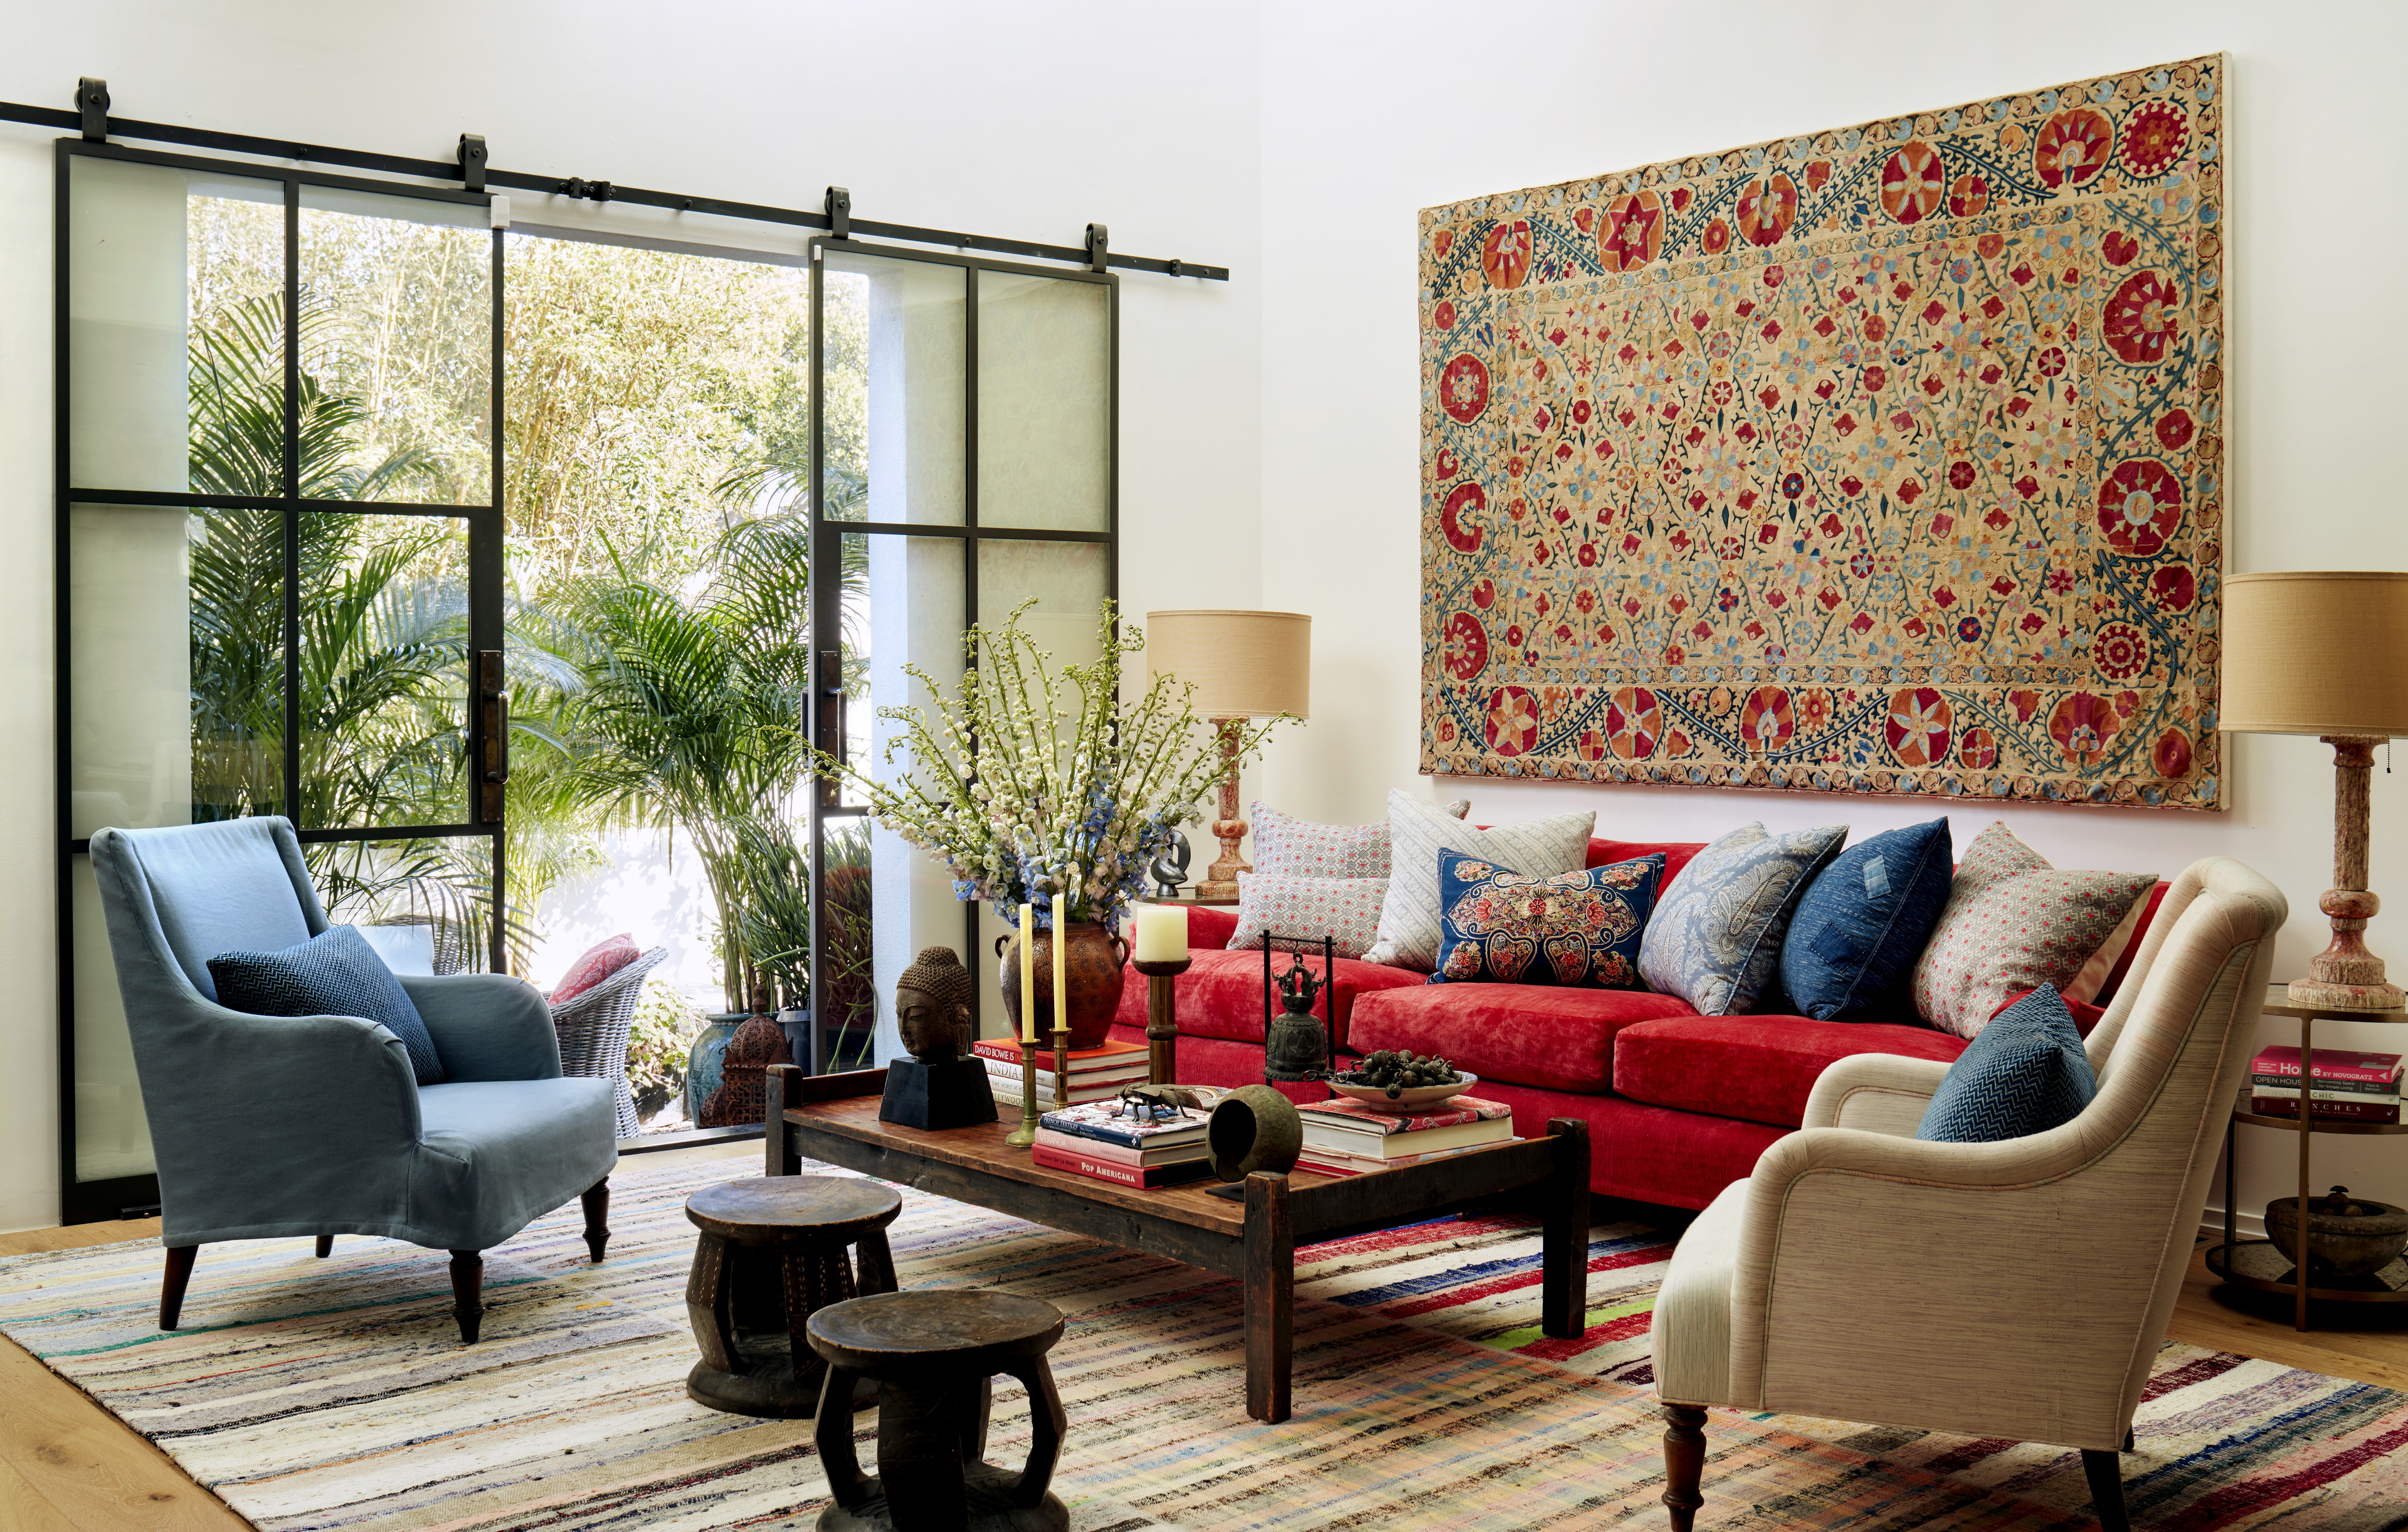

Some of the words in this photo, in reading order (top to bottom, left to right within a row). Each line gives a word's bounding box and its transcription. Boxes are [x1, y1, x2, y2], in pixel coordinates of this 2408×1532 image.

[974, 1045, 991, 1056] DAVID
[991, 1048, 1009, 1060] BOWIE
[1010, 1052, 1014, 1061] IS
[990, 1062, 1018, 1079] INDIA
[2280, 1063, 2321, 1077] Hoe
[2333, 1072, 2373, 1080] NOVOGRATZ
[2291, 1102, 2361, 1112] RNCHES
[1043, 1116, 1060, 1126] FRENCH
[1060, 1120, 1079, 1129] TEXTILES
[1038, 1132, 1067, 1148] VERANDA
